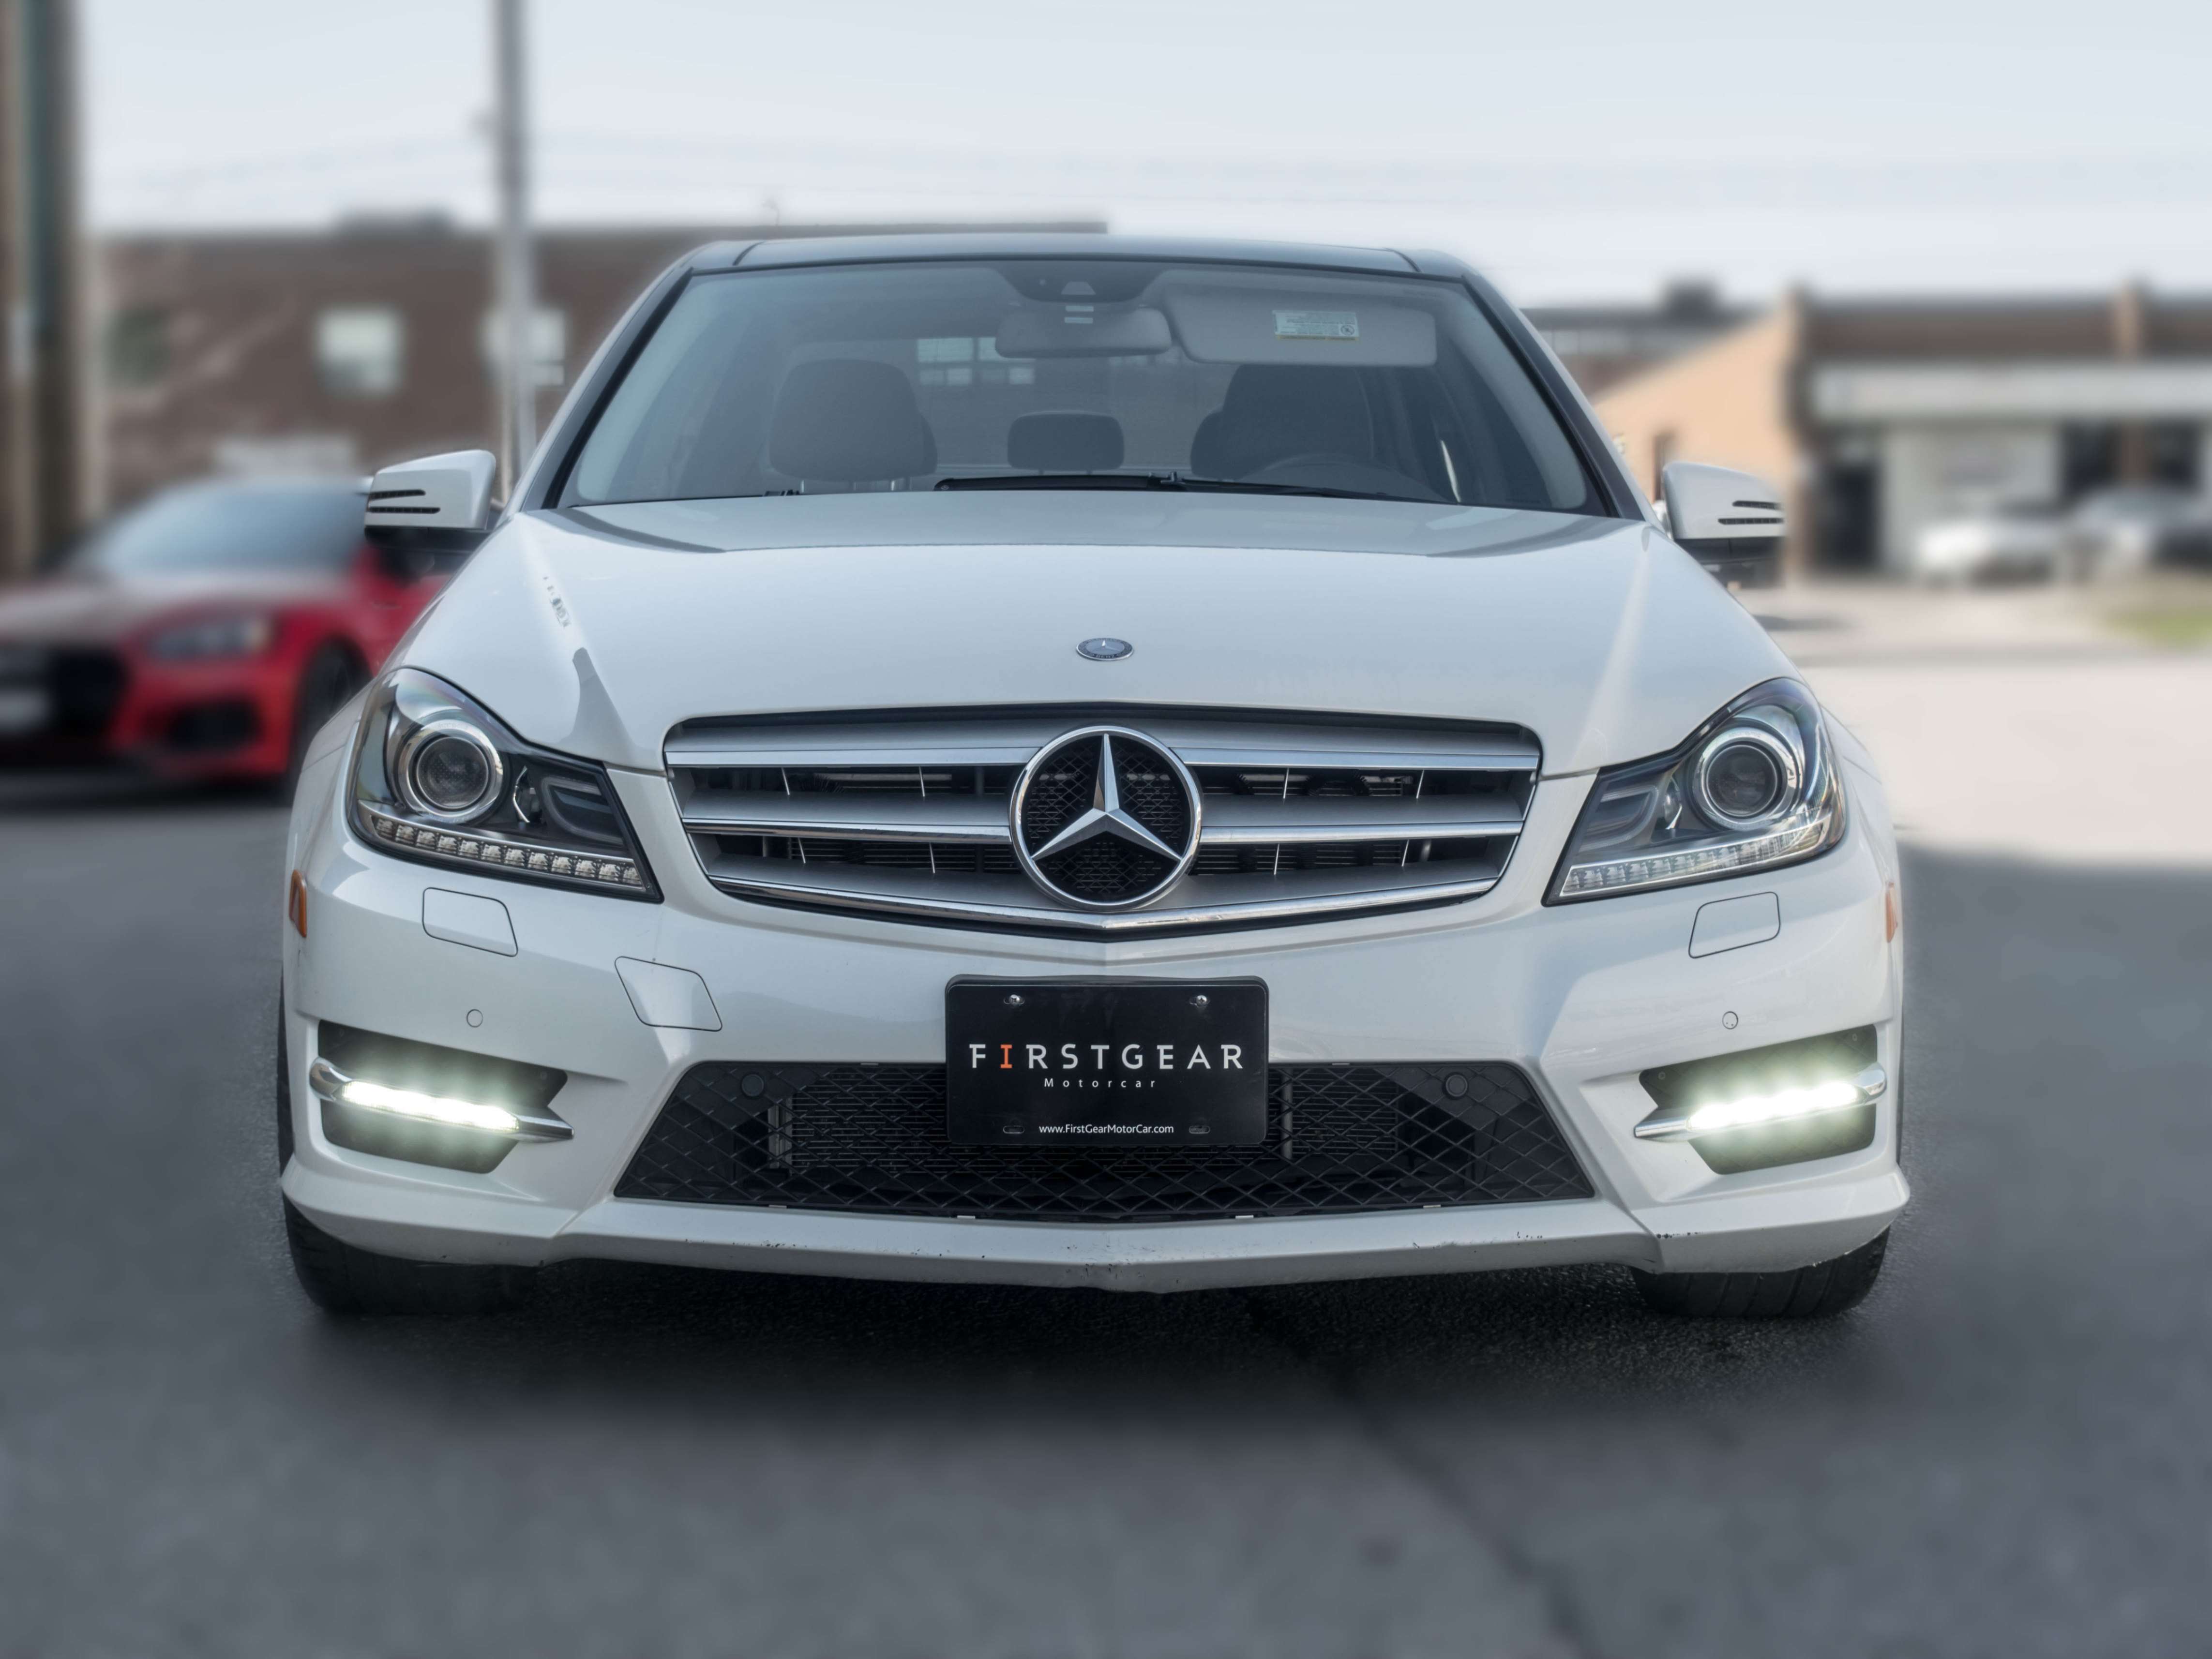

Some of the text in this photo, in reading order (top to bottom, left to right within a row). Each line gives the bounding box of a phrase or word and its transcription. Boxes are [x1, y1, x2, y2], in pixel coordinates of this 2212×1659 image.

[969, 1043, 1243, 1070] FIRSTGEAR
[1044, 1077, 1155, 1088] Motorcar
[1038, 1123, 1174, 1134] www.FirstGearMotorCar.com
